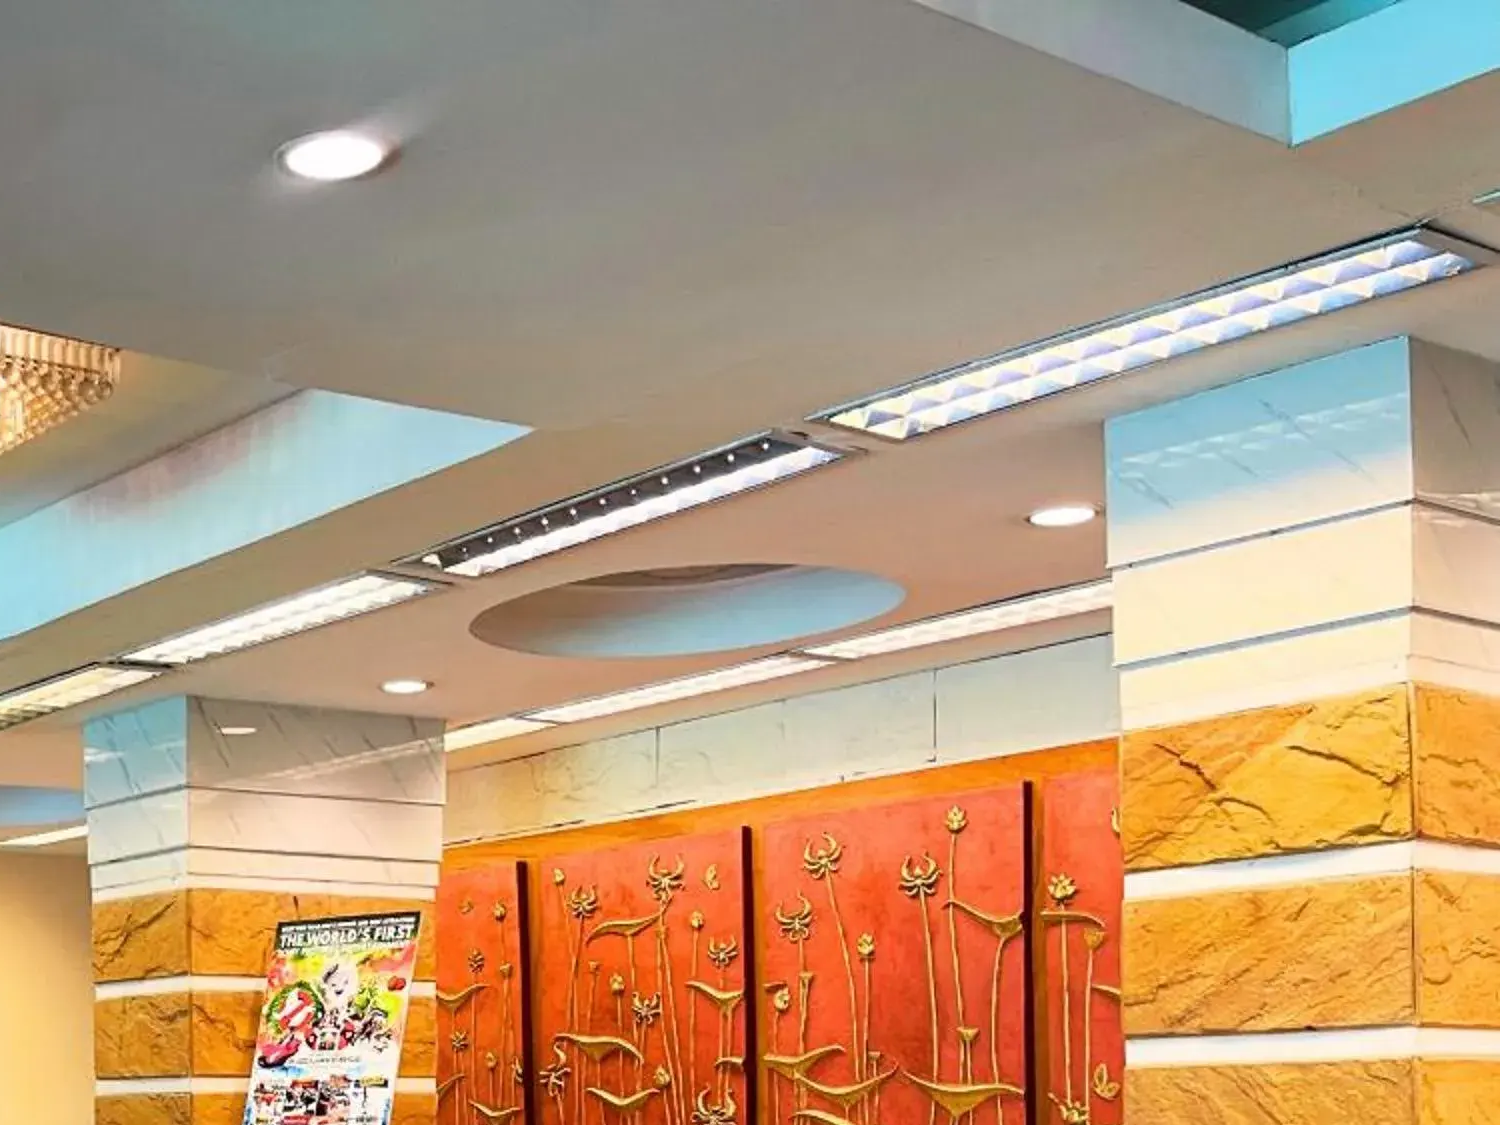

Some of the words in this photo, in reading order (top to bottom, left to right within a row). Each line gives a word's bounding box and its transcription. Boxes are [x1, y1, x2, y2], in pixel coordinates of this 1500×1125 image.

[280, 932, 304, 949] THE
[306, 926, 372, 946] WORLD'S
[373, 924, 415, 941] FIRST
